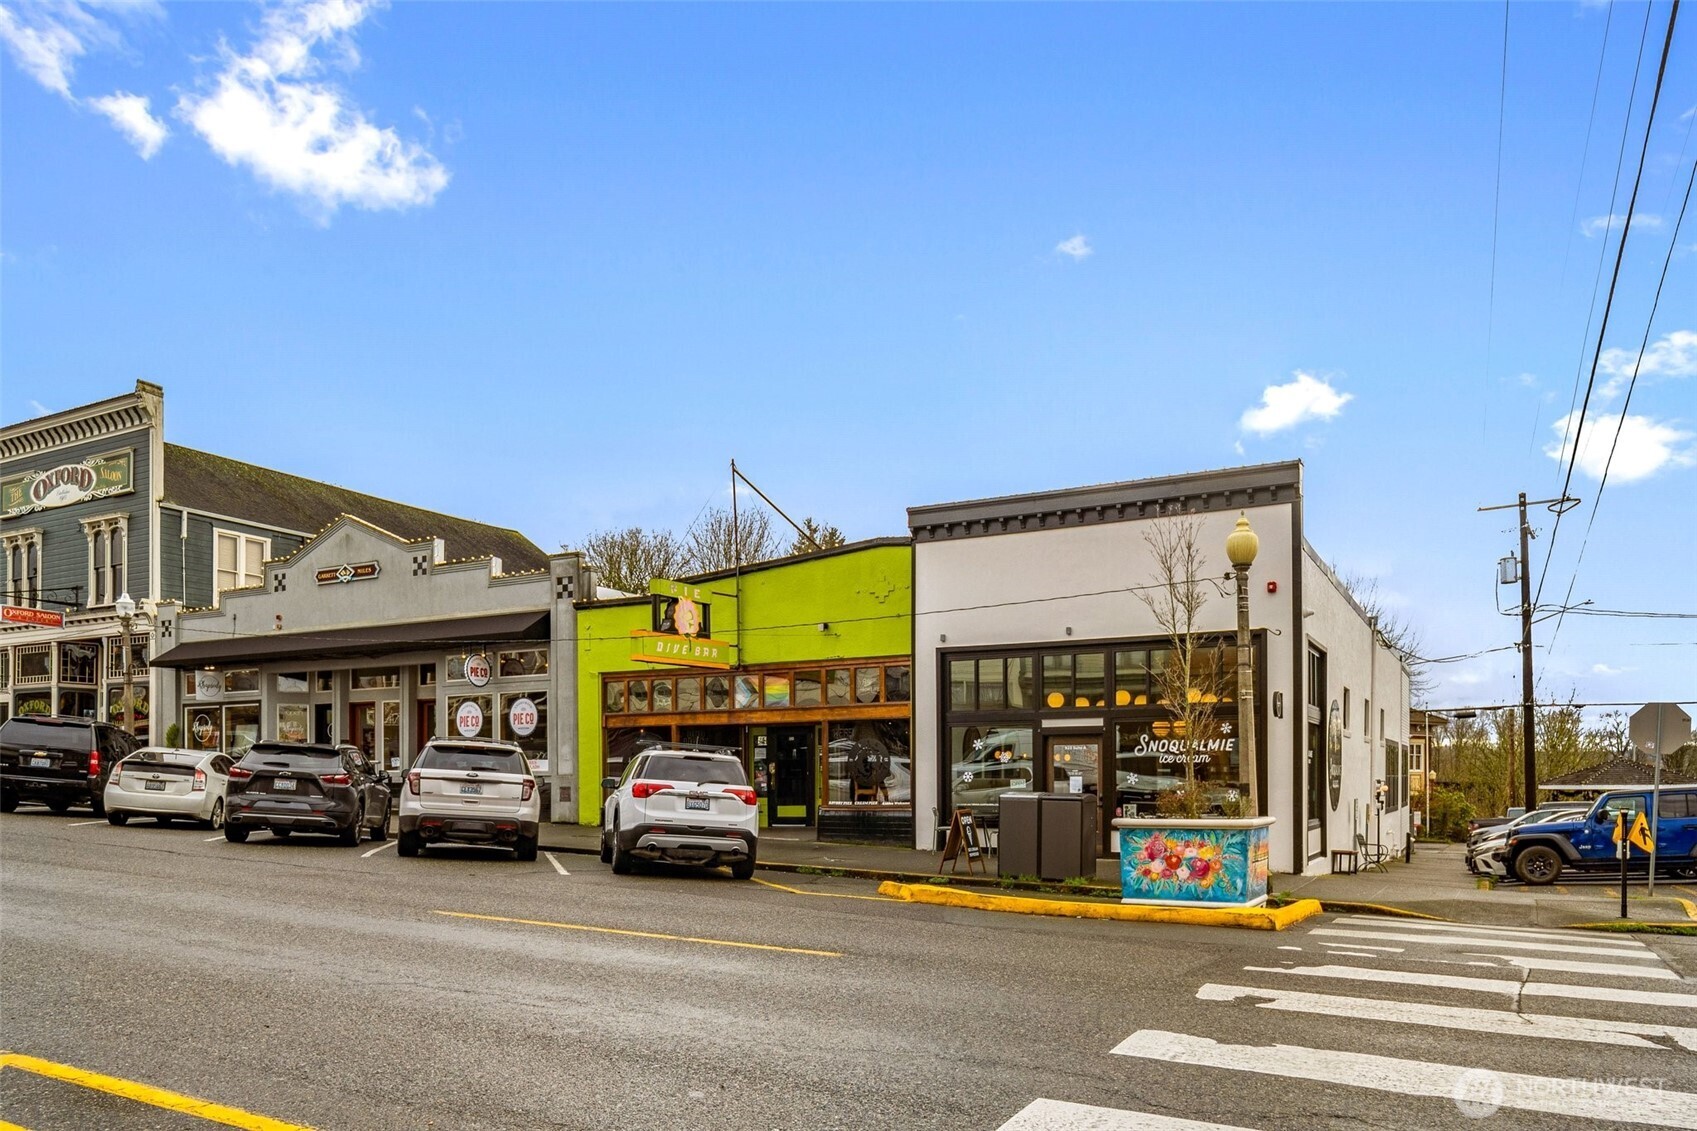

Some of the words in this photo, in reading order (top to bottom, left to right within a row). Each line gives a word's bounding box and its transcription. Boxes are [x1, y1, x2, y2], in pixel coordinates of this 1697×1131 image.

[32, 467, 93, 502] OXFORD
[670, 585, 701, 599] PIE
[3, 608, 35, 618] OXFORD
[36, 612, 61, 620] SALOON
[656, 641, 688, 655] DIVE
[694, 646, 718, 659] BAR
[470, 666, 480, 678] PIE
[480, 667, 488, 678] CO
[18, 700, 51, 715] OXFORD
[112, 698, 149, 715] OXRD
[459, 715, 470, 728] PIE
[470, 715, 480, 728] CO
[512, 713, 524, 726] PIE
[524, 712, 535, 725] CO
[1159, 753, 1175, 763] ice
[1176, 753, 1212, 763] cram
